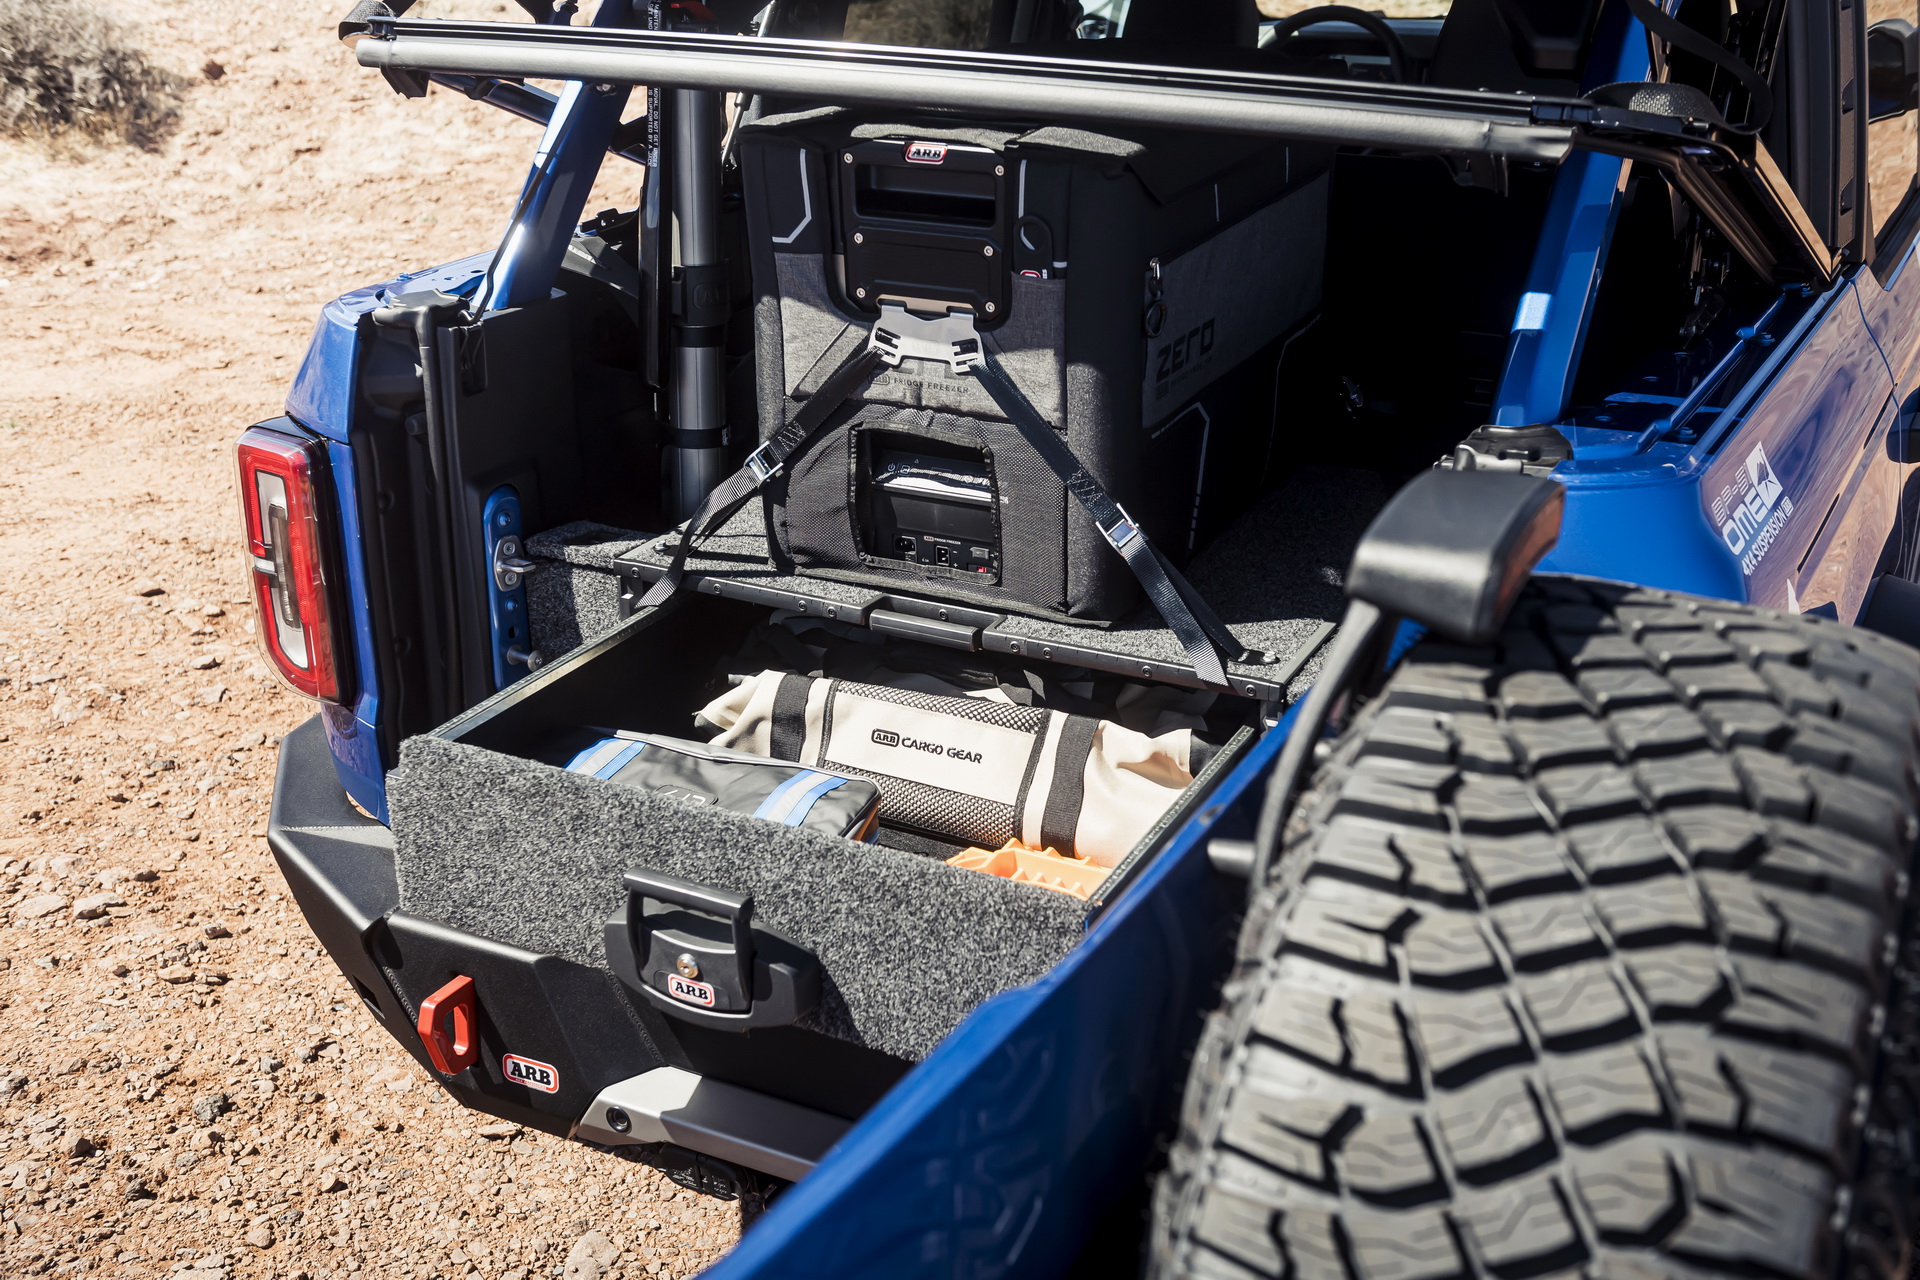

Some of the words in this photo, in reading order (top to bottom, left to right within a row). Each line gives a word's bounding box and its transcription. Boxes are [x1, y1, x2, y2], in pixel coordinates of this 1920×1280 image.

[912, 148, 942, 158] ARB
[894, 377, 924, 388] FRIDGE
[927, 381, 969, 394] FREEZER
[1722, 486, 1769, 556] OME
[1751, 505, 1788, 562] SUSPENSION
[875, 733, 897, 744] ARB
[901, 737, 944, 756] CARGO
[946, 747, 983, 764] GEAR
[675, 981, 709, 1000] ARB
[510, 1060, 552, 1086] ARB
